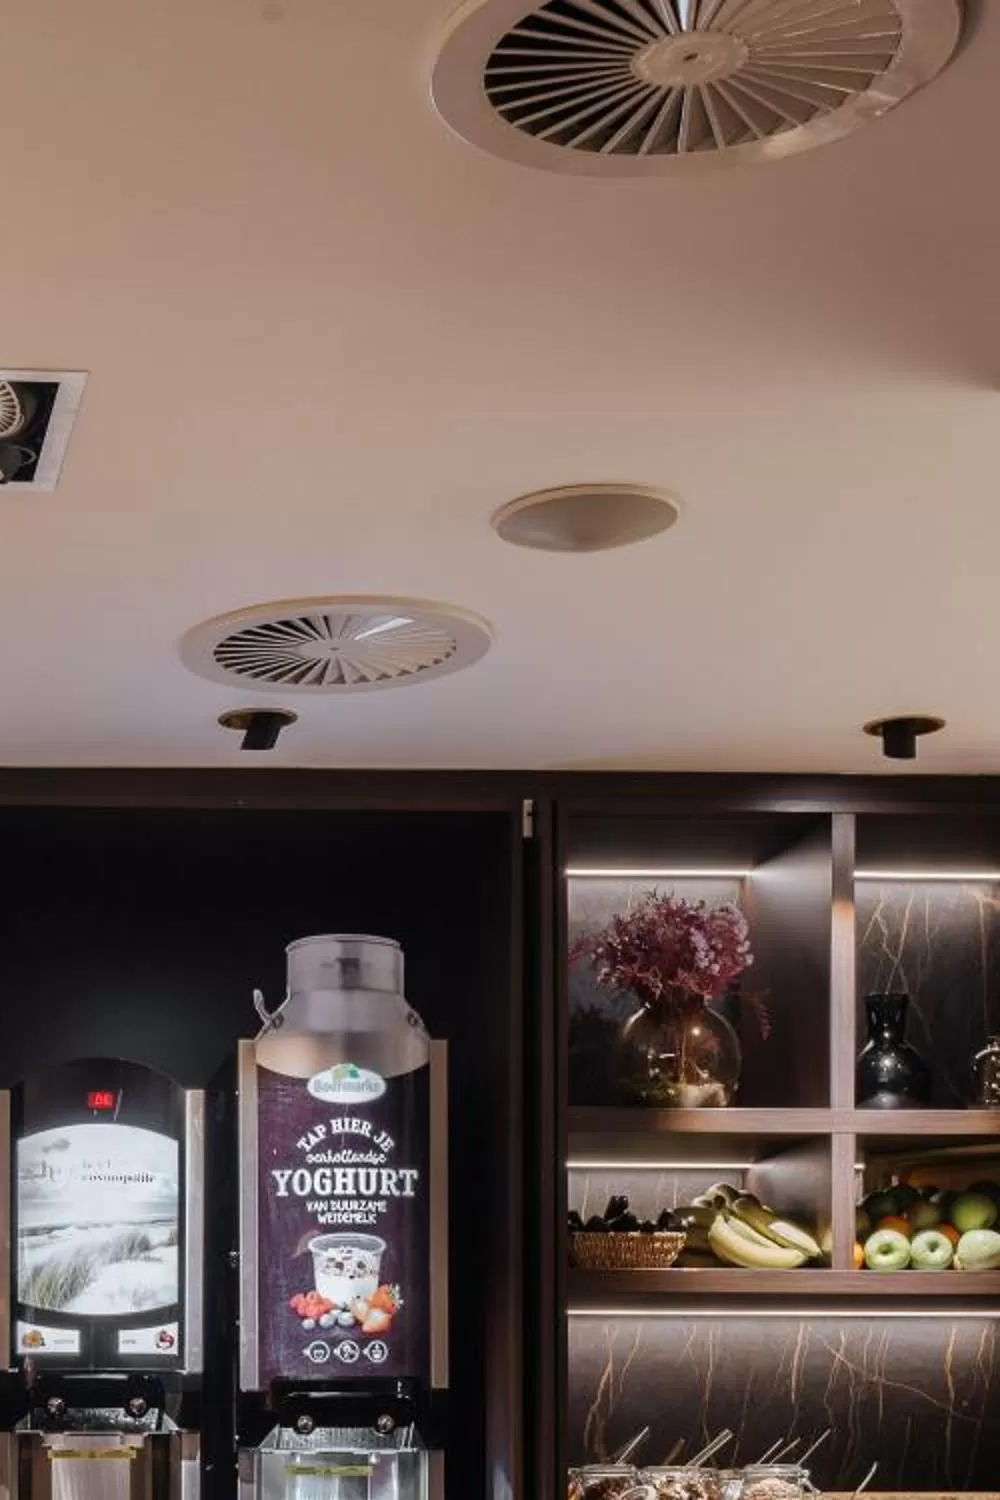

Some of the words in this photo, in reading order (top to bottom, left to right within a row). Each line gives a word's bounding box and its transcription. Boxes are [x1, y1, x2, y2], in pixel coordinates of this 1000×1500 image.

[296, 1124, 327, 1152] TAP
[329, 1117, 372, 1137] HIER
[373, 1130, 395, 1153] JE
[271, 1167, 419, 1197] YOGHURT
[305, 1200, 328, 1212] VAN
[316, 1212, 377, 1224] WEIDEMELK
